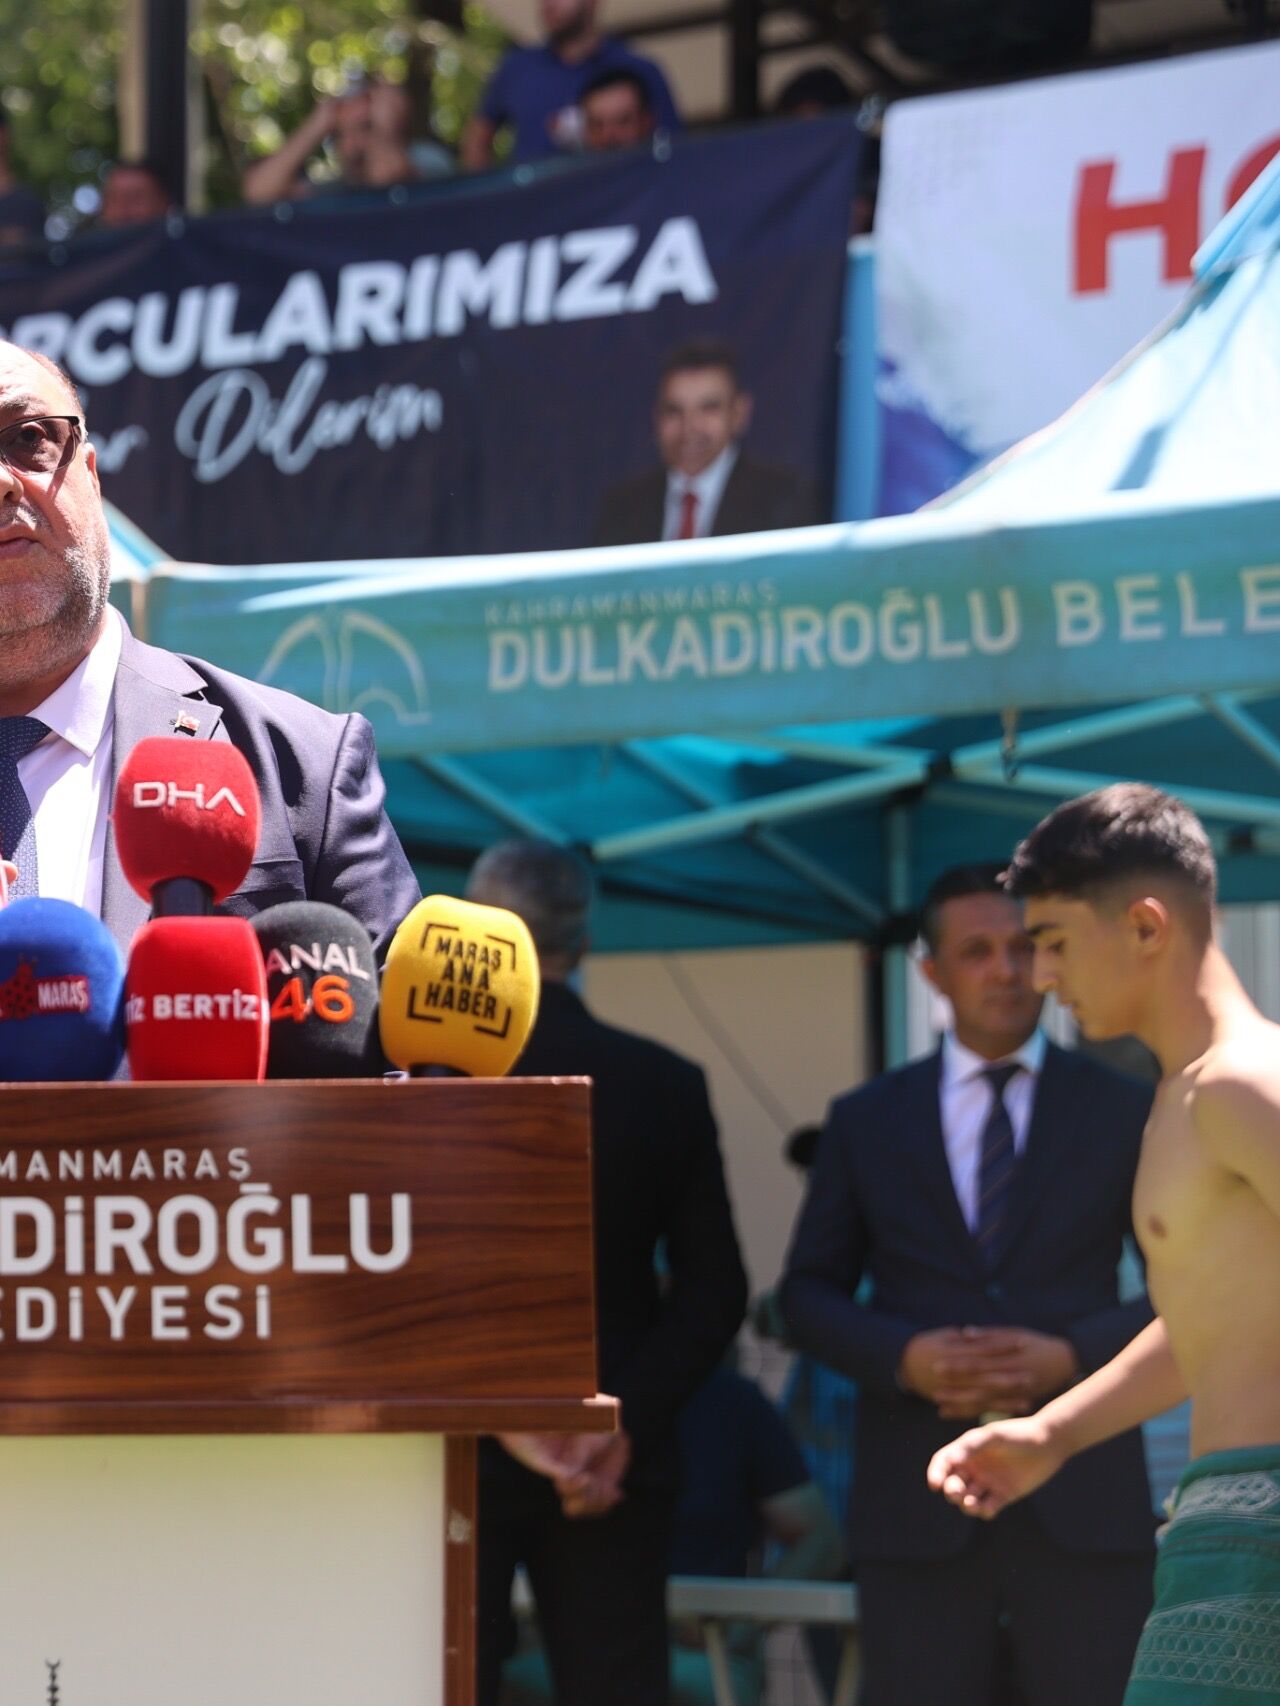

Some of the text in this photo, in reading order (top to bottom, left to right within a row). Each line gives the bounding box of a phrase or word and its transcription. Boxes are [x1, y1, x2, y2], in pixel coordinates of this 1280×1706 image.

[133, 780, 246, 817] DHA
[266, 942, 371, 982] ANAL
[435, 935, 502, 974] MARAŞ
[441, 959, 490, 991] ANA
[152, 988, 260, 1021] BERTİZ
[271, 974, 356, 1024] 46
[424, 982, 497, 1020] HABER
